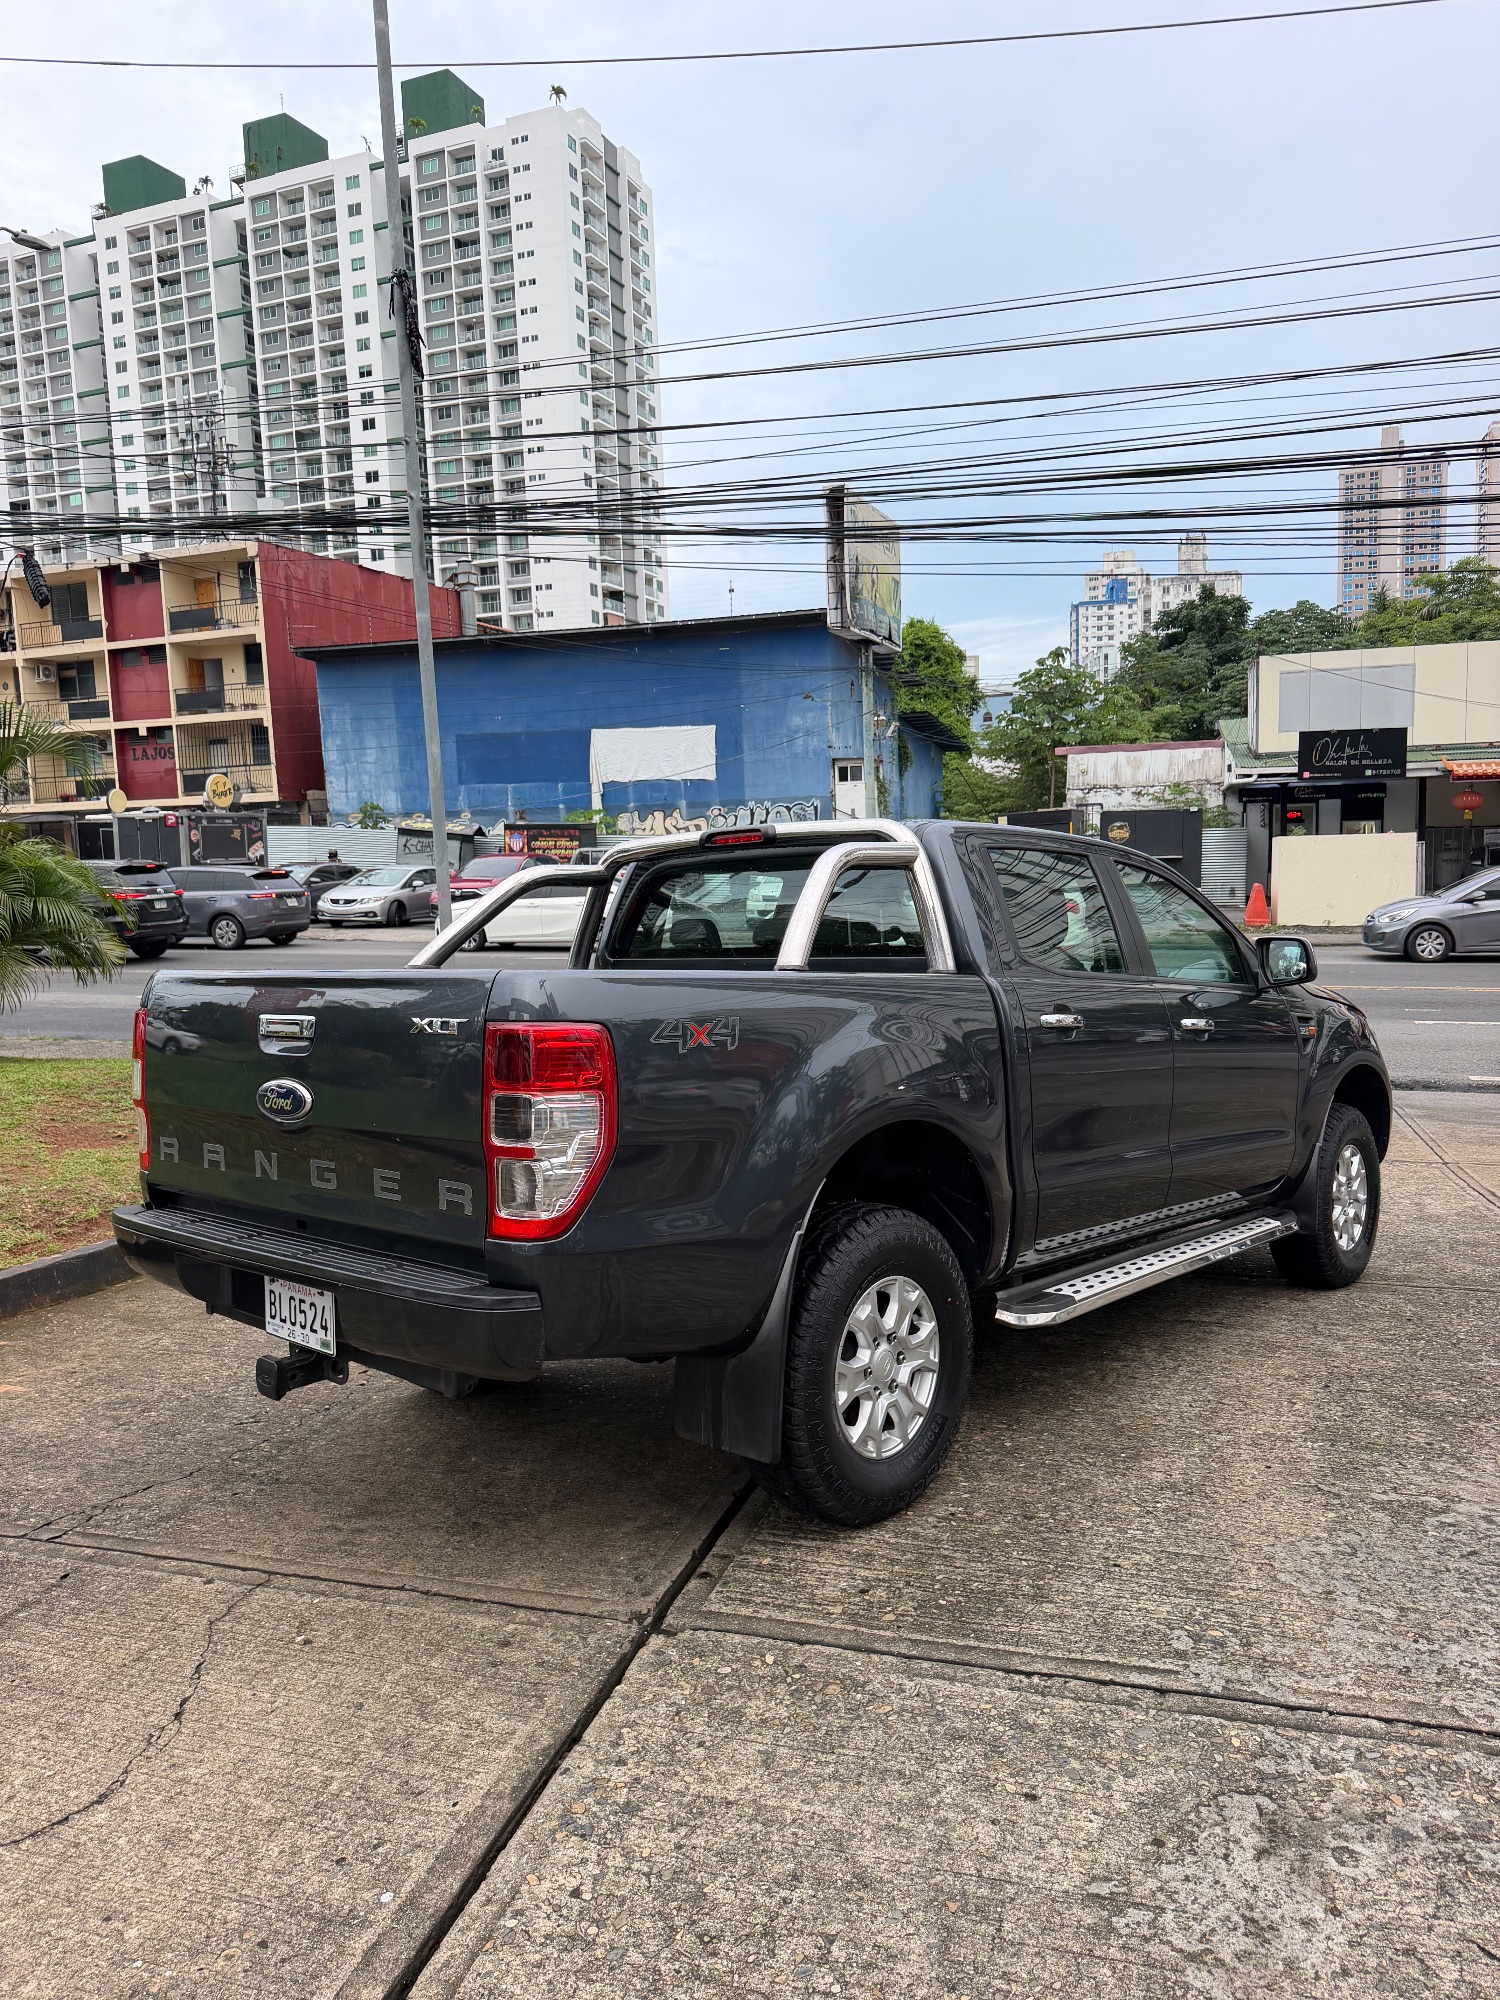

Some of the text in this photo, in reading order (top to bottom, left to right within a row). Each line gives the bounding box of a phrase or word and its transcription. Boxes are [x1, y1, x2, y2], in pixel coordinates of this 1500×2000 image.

[132, 747, 175, 761] LAJOS
[409, 1017, 469, 1035] XLT
[264, 1087, 293, 1110] Ford
[159, 1136, 473, 1215] RANGER
[282, 1280, 313, 1298] PANAMA
